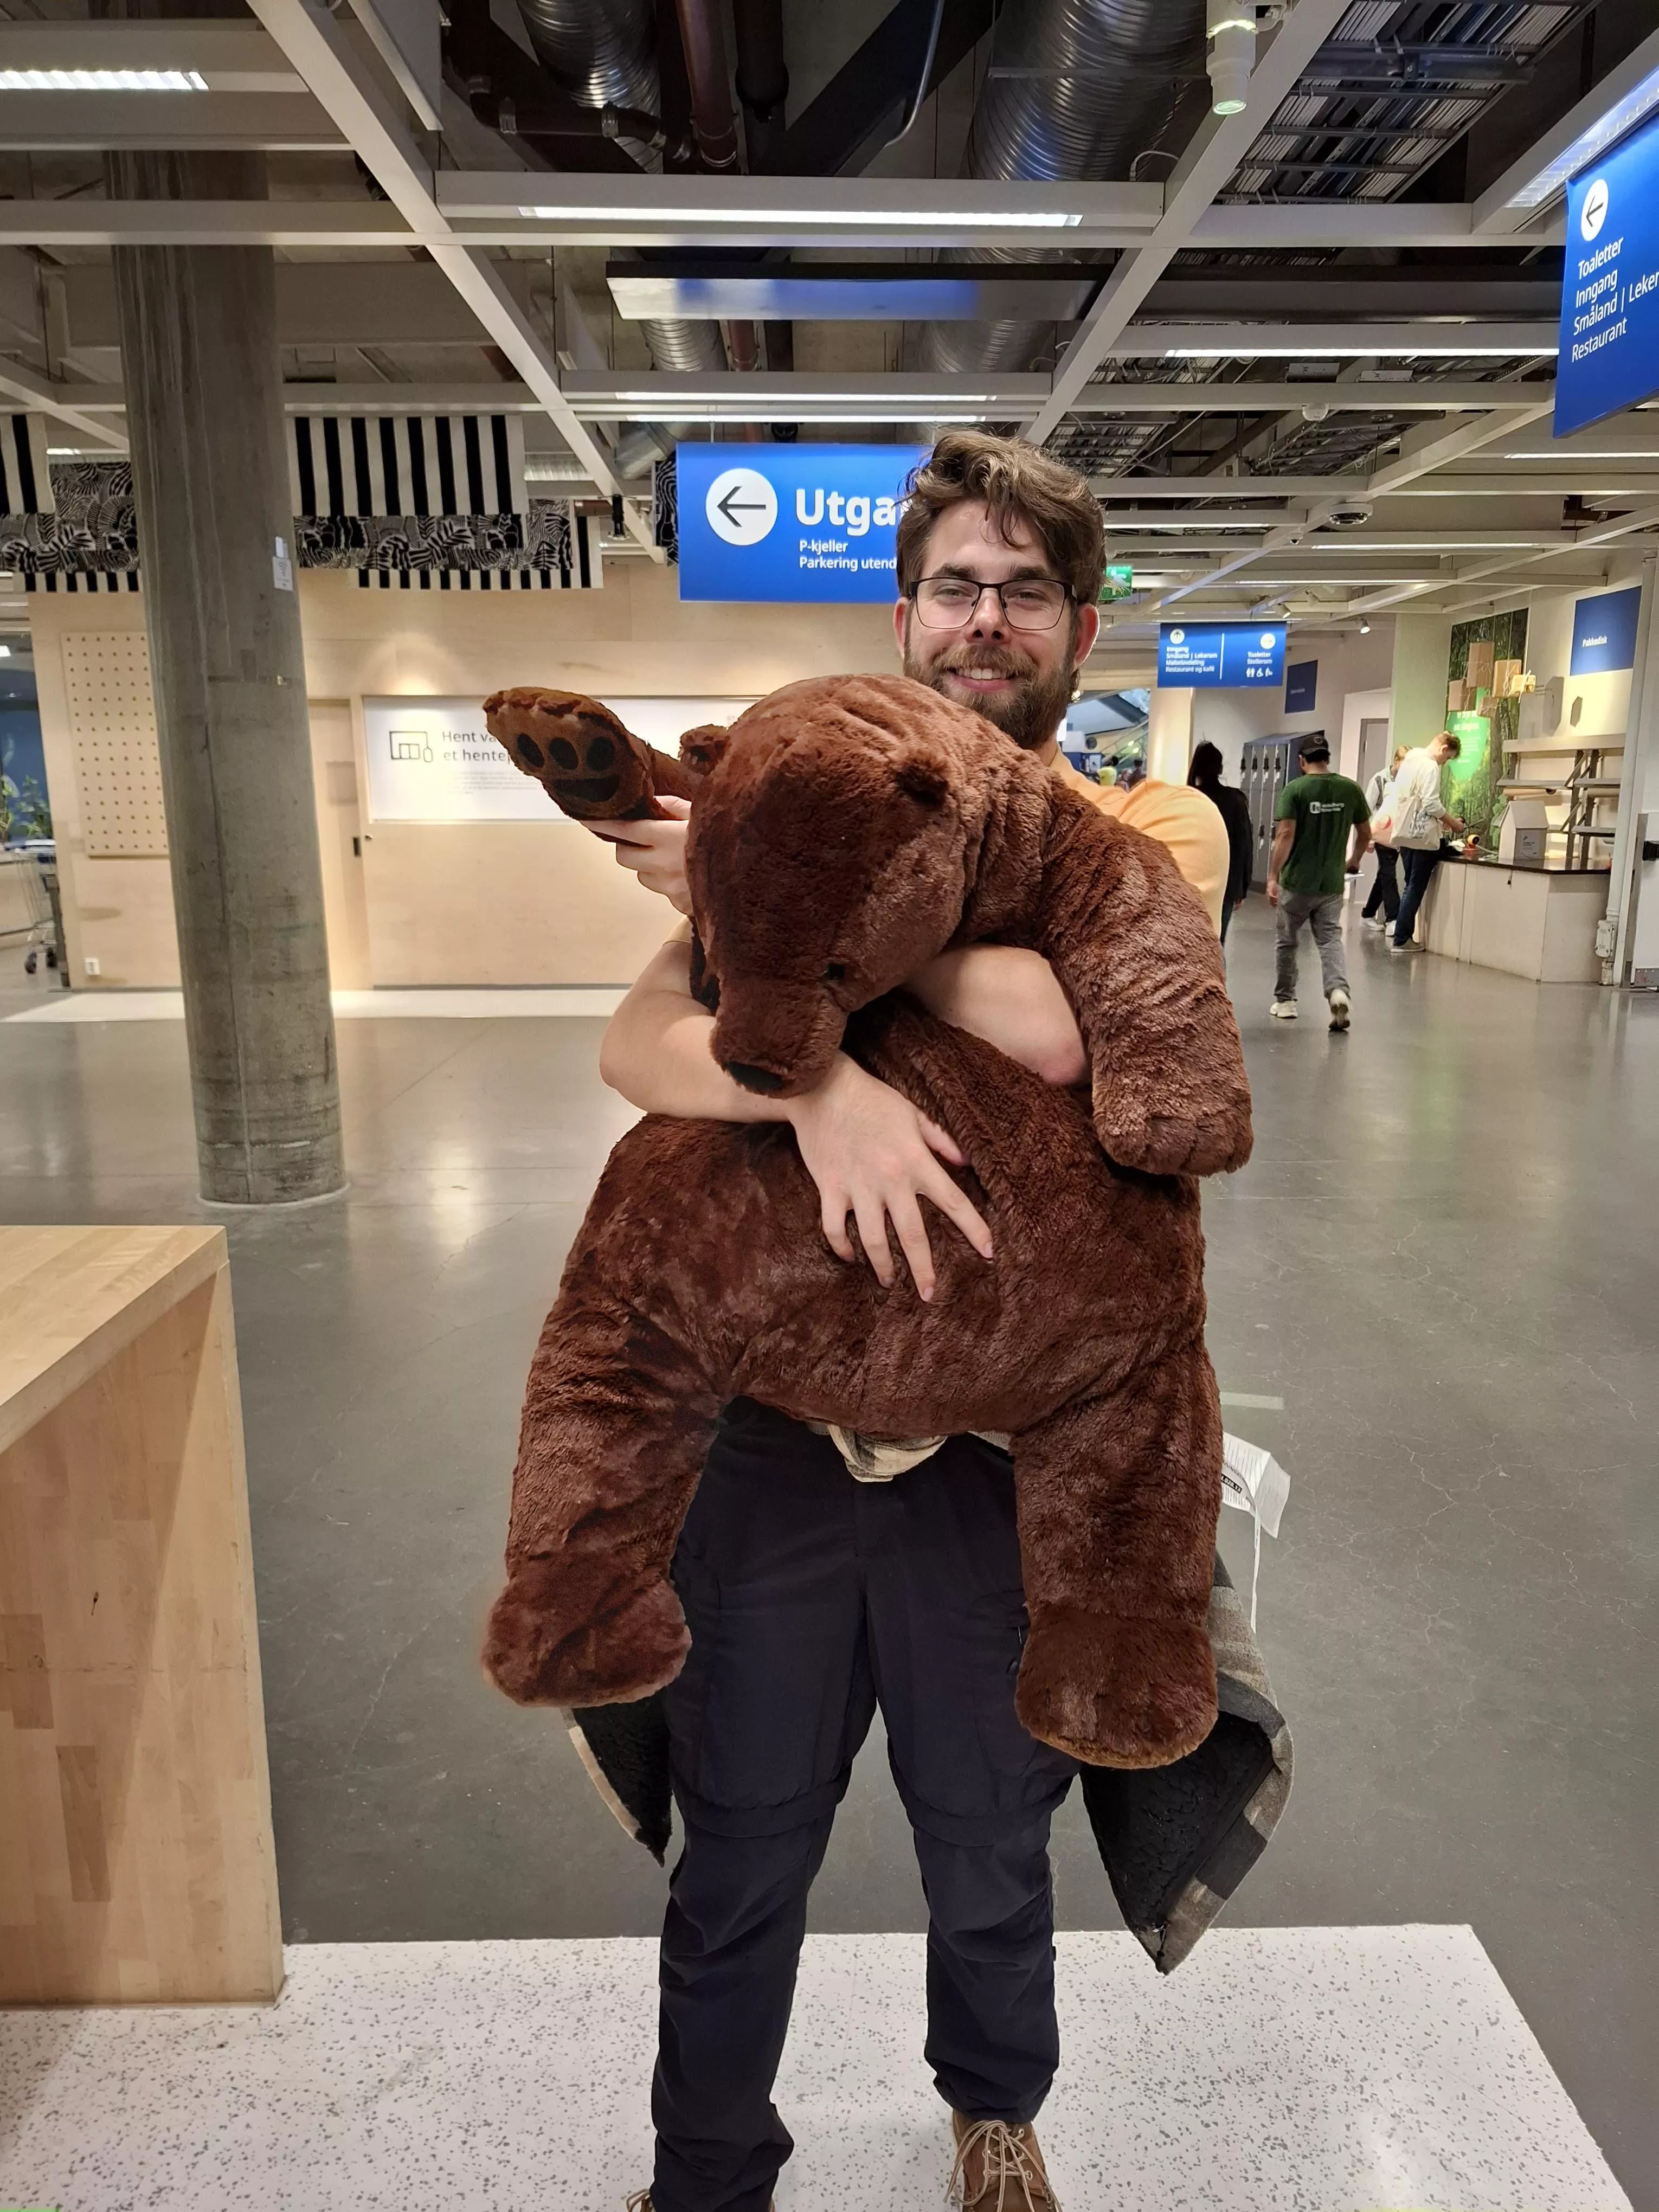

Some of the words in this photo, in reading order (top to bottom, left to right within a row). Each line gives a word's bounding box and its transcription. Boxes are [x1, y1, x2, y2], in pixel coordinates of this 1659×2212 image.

[1578, 237, 1623, 280] Toaletter
[1576, 269, 1618, 308] Inngang
[1573, 291, 1618, 336] Småland
[1629, 270, 1659, 303] Leker
[1572, 317, 1627, 363] Restaurant
[799, 539, 848, 553] P-kjeller
[799, 557, 858, 573] Parkering
[861, 557, 898, 569] utend
[1583, 635, 1607, 647] Pakkedisk
[442, 731, 477, 742] Hent
[443, 750, 458, 760] et
